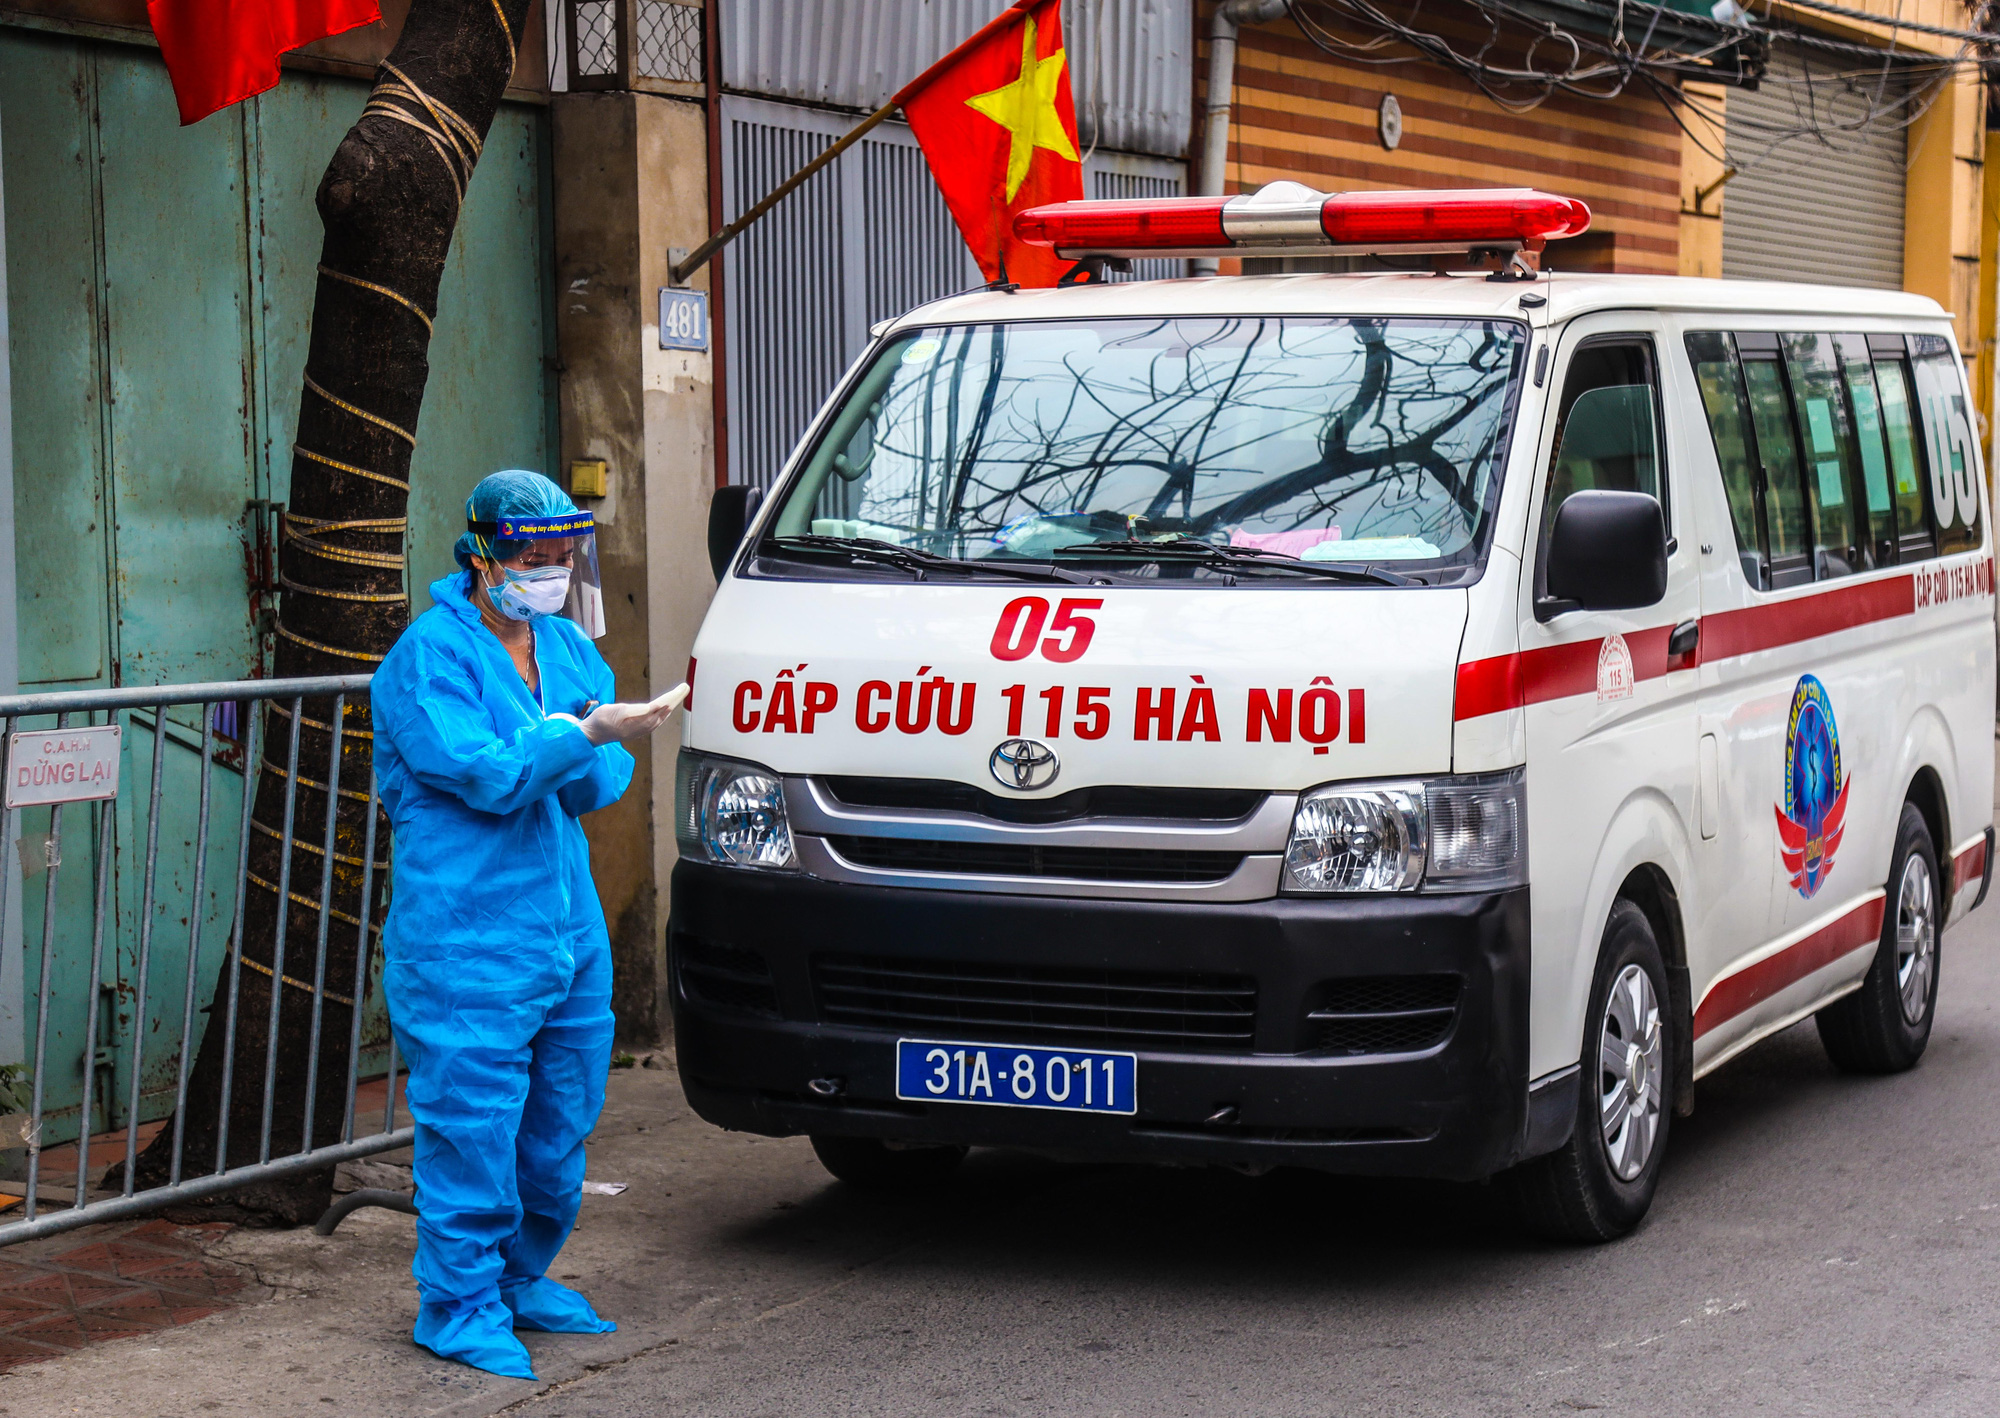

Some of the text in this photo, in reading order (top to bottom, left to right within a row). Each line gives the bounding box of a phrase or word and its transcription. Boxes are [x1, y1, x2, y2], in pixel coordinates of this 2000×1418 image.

[664, 300, 701, 340] 481
[1916, 361, 1978, 529] 05
[519, 525, 536, 533] Chung
[1916, 564, 1933, 610] CẤP
[1934, 563, 1949, 606] CỨU
[1950, 566, 1964, 601] 115
[1964, 557, 1975, 599] HÀ
[990, 595, 1104, 664] 05
[1610, 669, 1621, 687] 115
[733, 663, 1367, 756] CẤP CỨU 115 HÀ NỘI
[17, 758, 112, 788] DỪNG LẠI
[924, 1047, 1115, 1107] 31A-8011
